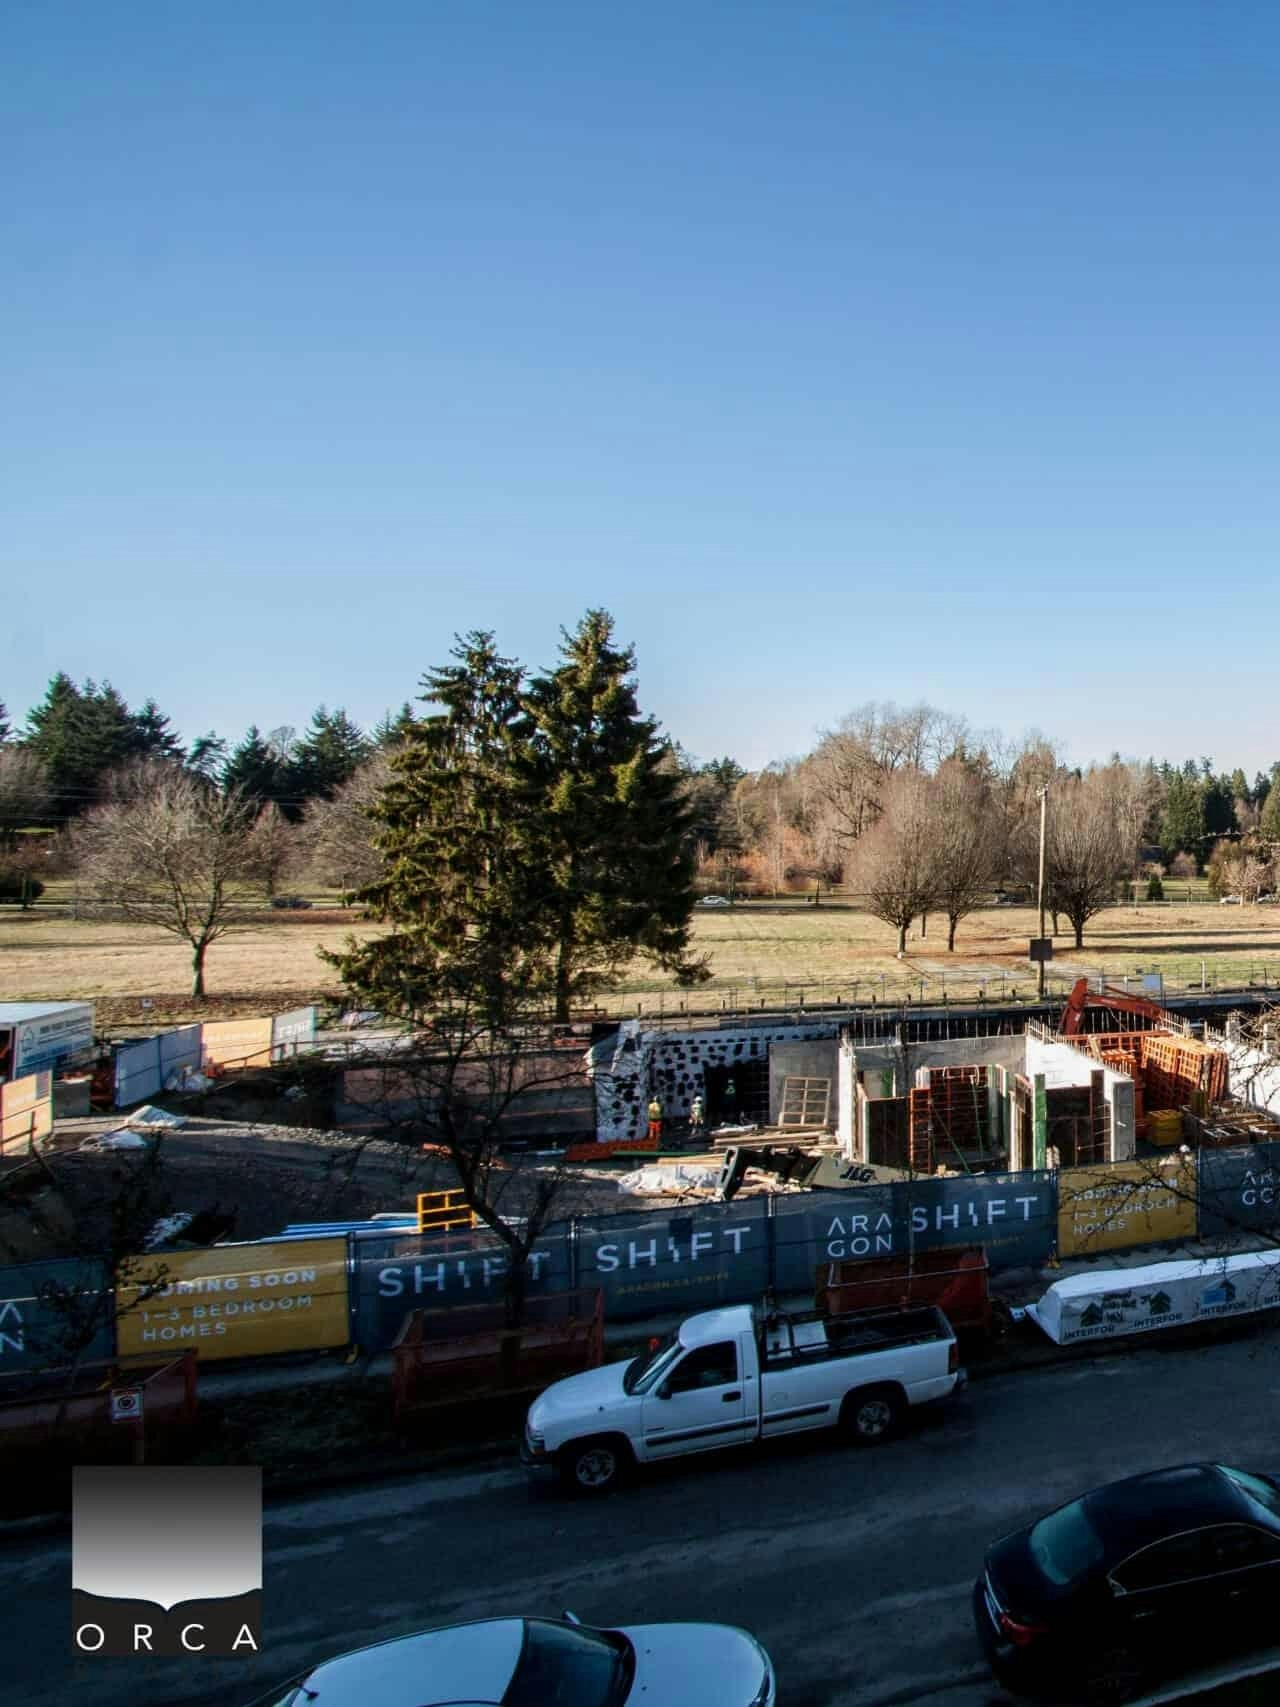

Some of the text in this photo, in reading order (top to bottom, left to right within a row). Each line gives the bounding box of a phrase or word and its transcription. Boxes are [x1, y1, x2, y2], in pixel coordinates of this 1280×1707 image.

[827, 1213, 892, 1237] ARA
[912, 1196, 1038, 1233] SHIFT
[595, 1227, 752, 1272] SHIFT
[827, 1233, 893, 1257] GON
[140, 1270, 317, 1298] OMING SOON
[379, 1250, 551, 1297] SHIFT
[192, 1295, 314, 1319] BEDROOM
[143, 1323, 227, 1341] HOMES
